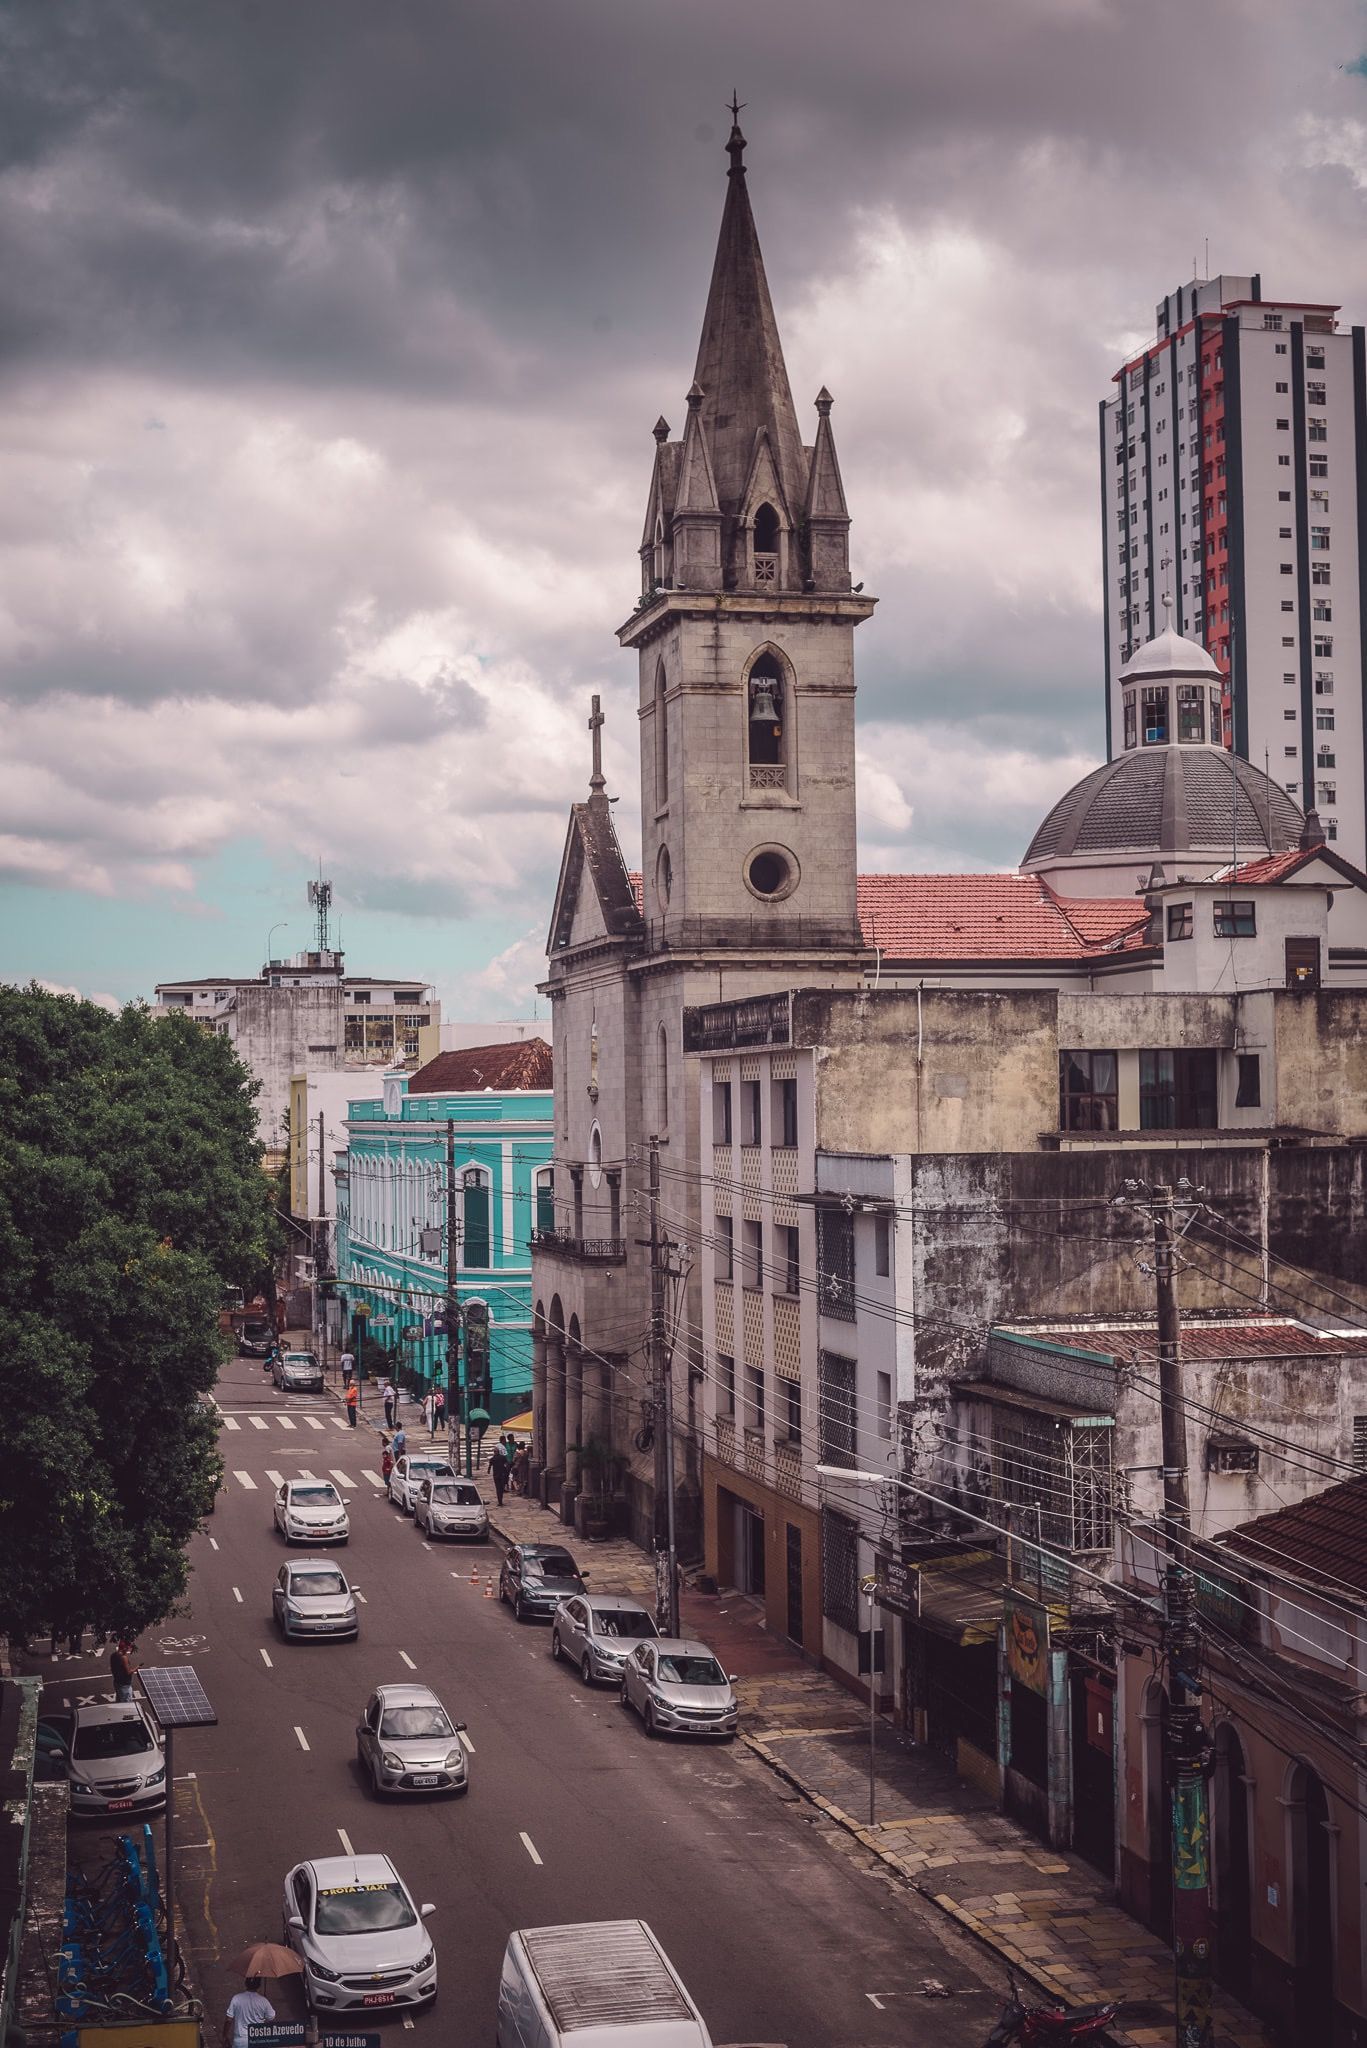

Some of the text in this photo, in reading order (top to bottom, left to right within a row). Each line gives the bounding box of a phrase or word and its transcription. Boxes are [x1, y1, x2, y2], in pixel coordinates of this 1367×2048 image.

[329, 1887, 357, 1895] ROTA
[365, 1883, 388, 1892] TAXI
[249, 2024, 305, 2037] Costa Azevedo
[325, 2037, 367, 2047] 10 de Julho
